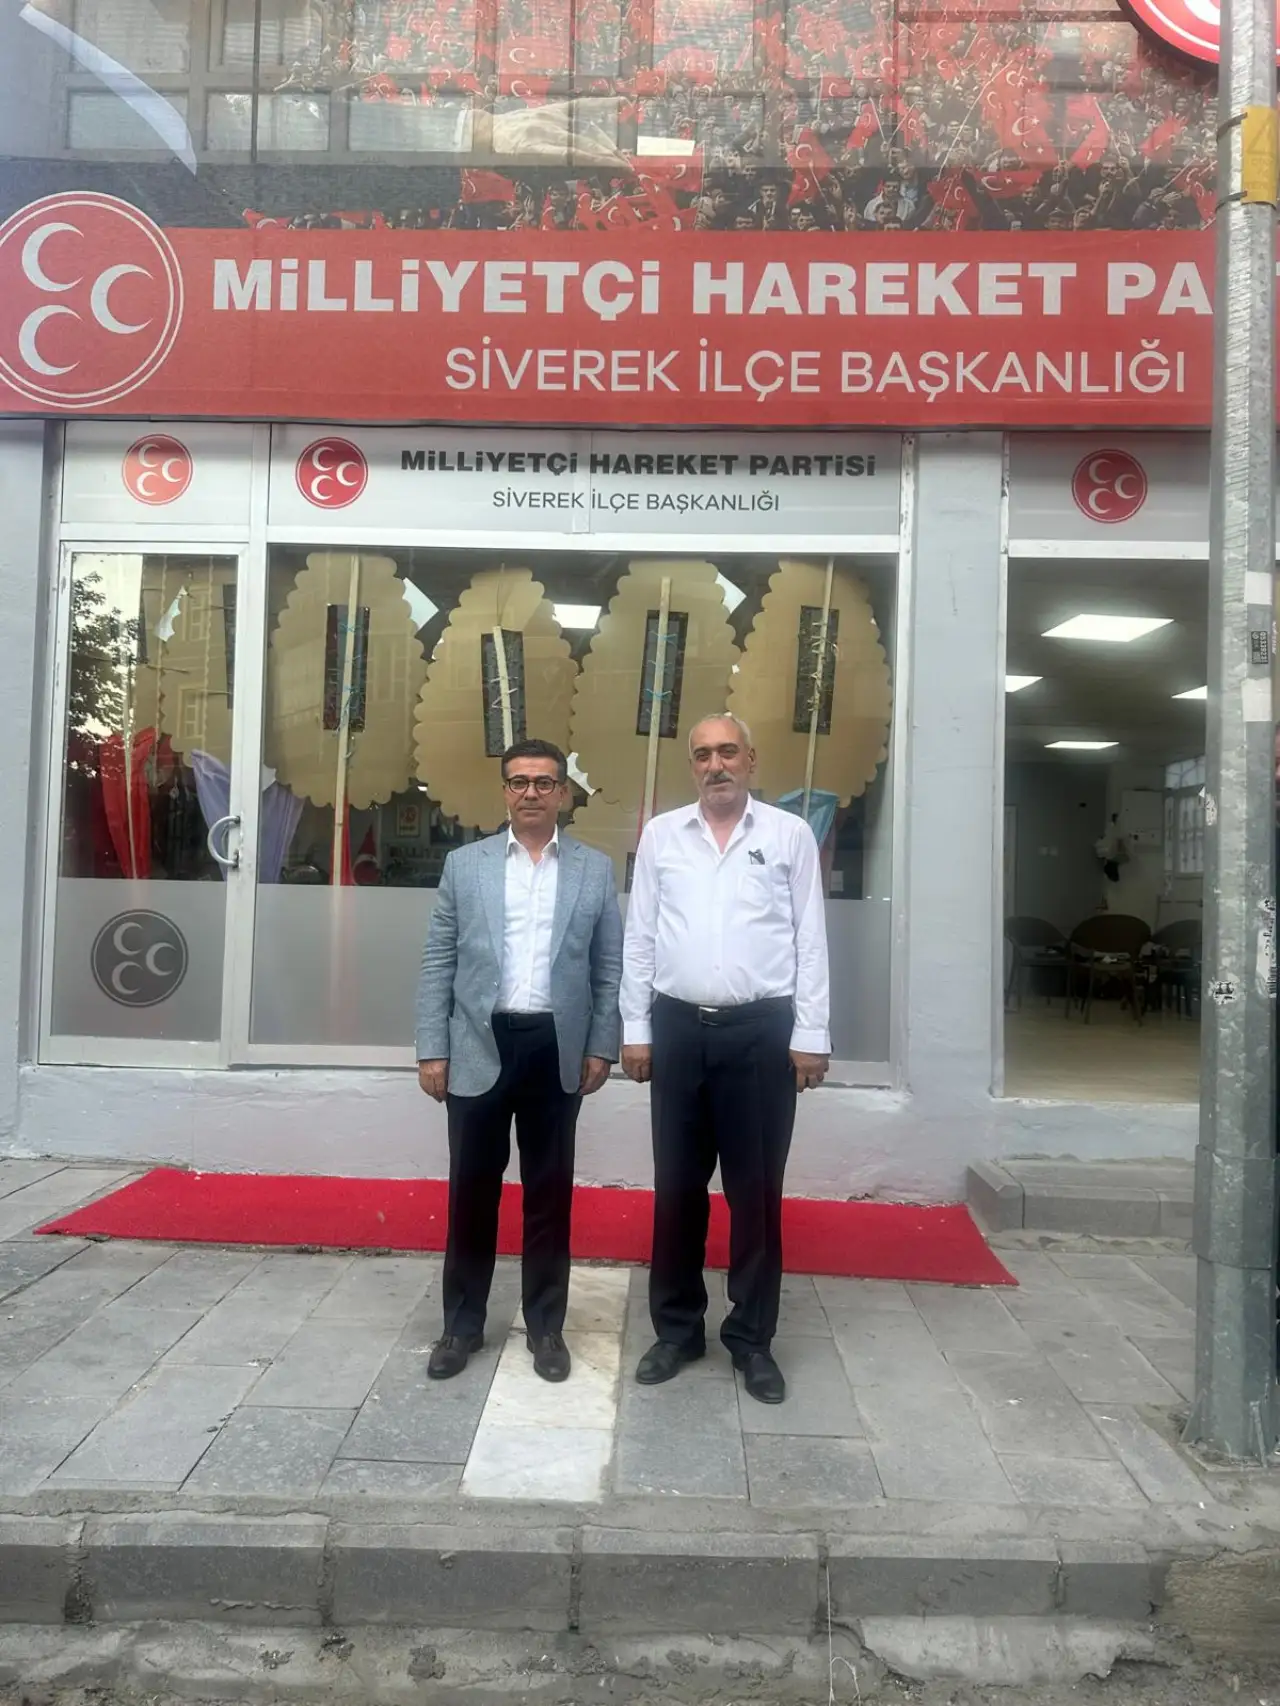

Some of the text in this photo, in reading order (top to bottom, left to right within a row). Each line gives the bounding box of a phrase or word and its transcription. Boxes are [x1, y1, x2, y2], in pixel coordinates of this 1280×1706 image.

[692, 260, 1077, 316] HAREKET
[445, 336, 1185, 403] SİVEREK İLÇE BAŞKANLIĞI
[590, 453, 739, 475] HAREKET
[492, 486, 780, 514] SİVEREK İLÇE BAŞKANLIĞI
